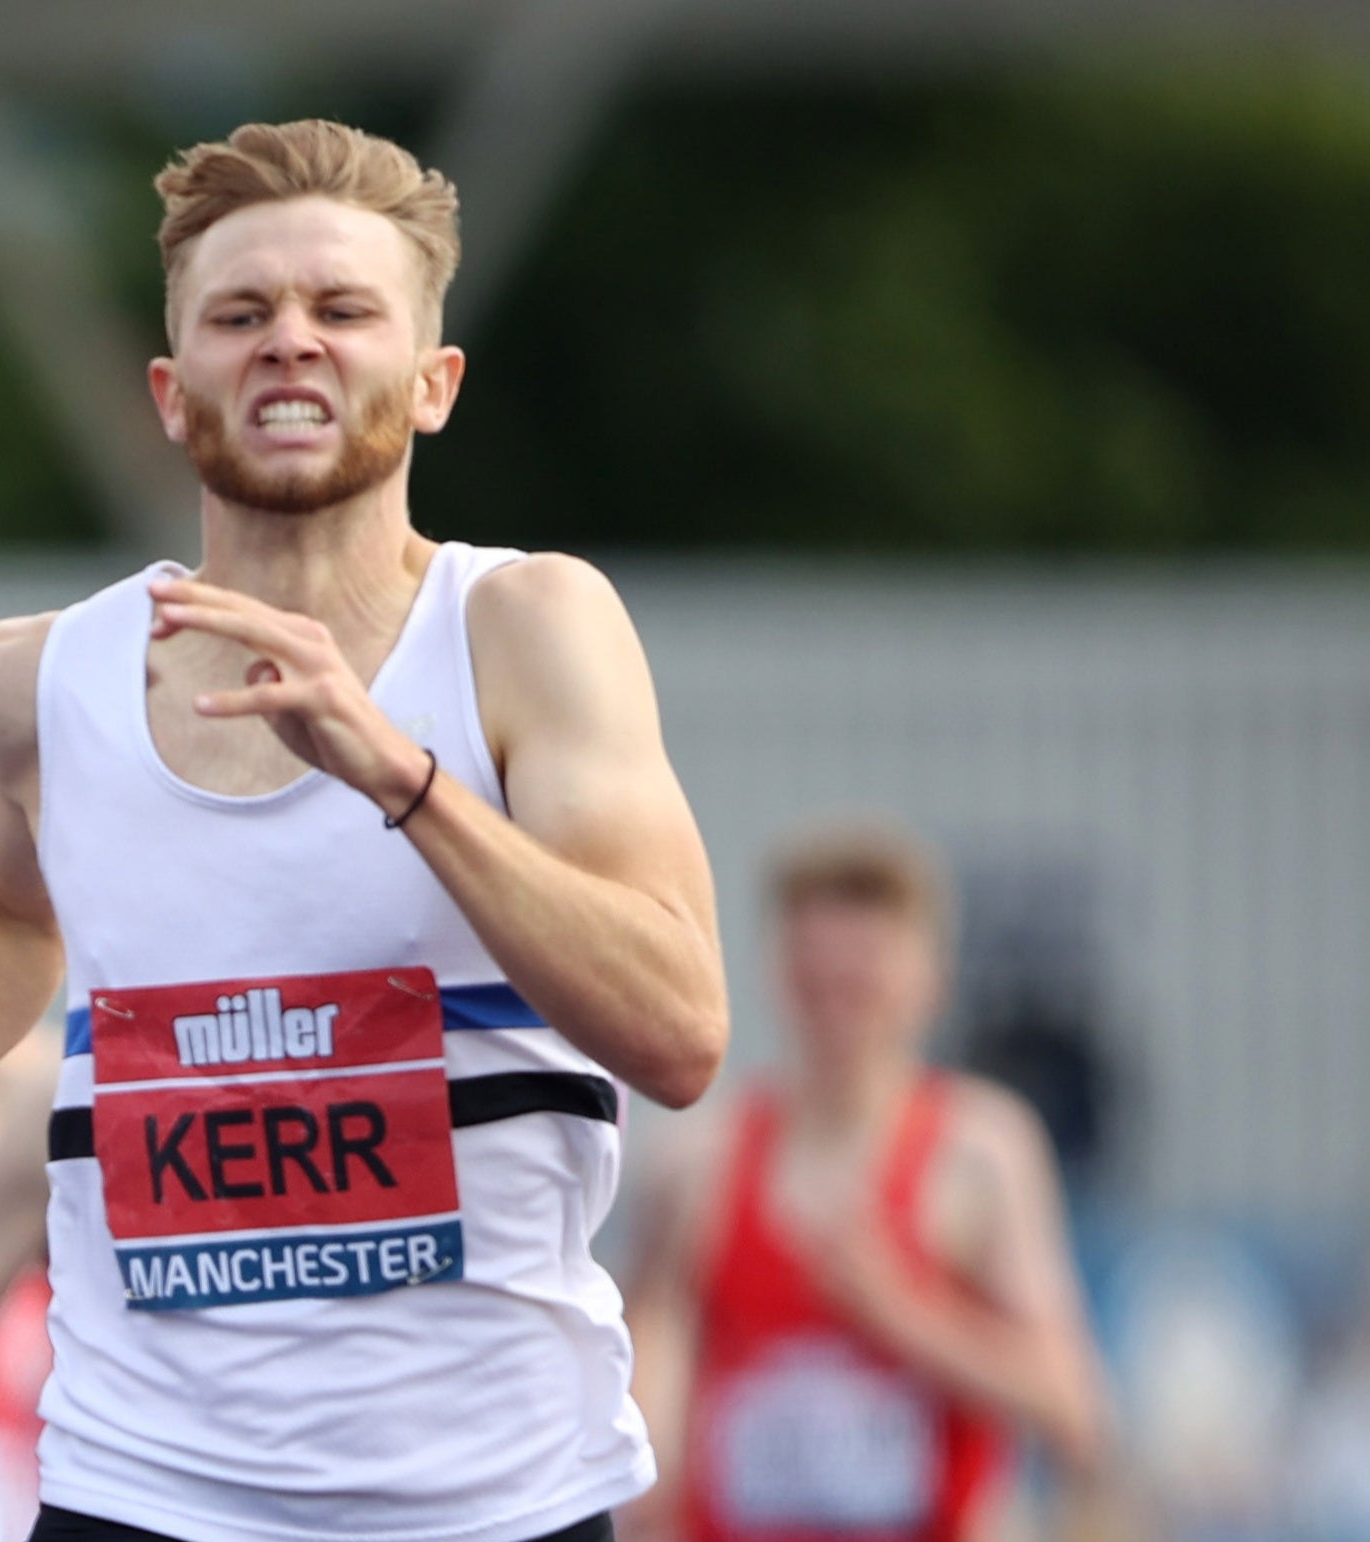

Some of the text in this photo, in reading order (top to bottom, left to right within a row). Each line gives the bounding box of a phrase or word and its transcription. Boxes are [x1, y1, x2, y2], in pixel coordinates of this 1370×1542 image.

[173, 988, 339, 1067] müller
[145, 1101, 397, 1205] KERR
[129, 1234, 438, 1298] MANCHESTER
